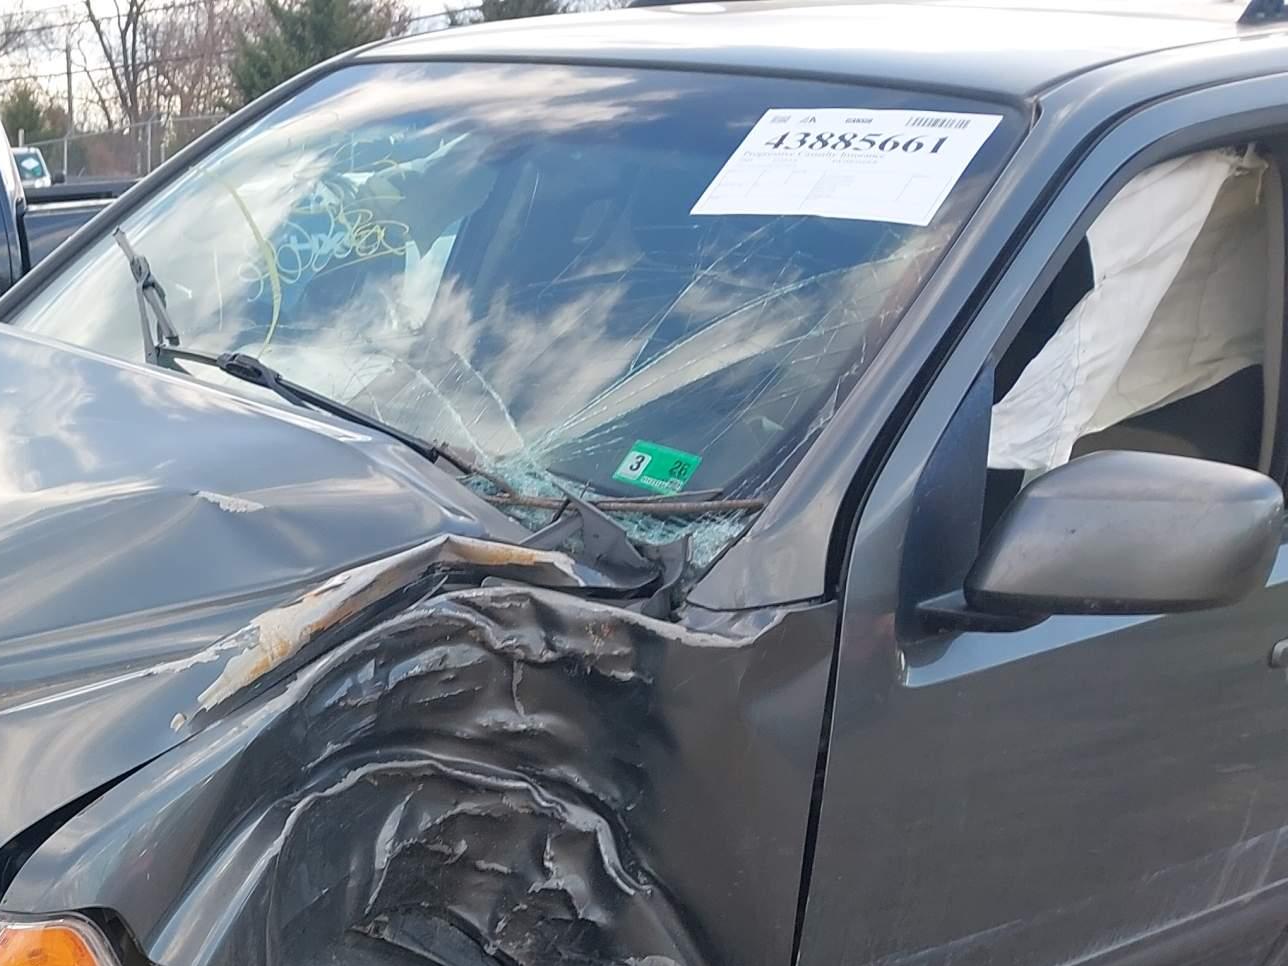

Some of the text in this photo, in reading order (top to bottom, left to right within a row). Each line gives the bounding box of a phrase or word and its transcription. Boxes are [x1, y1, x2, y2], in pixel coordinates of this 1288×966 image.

[765, 131, 949, 154] 43885661
[629, 455, 690, 479] 3 26
